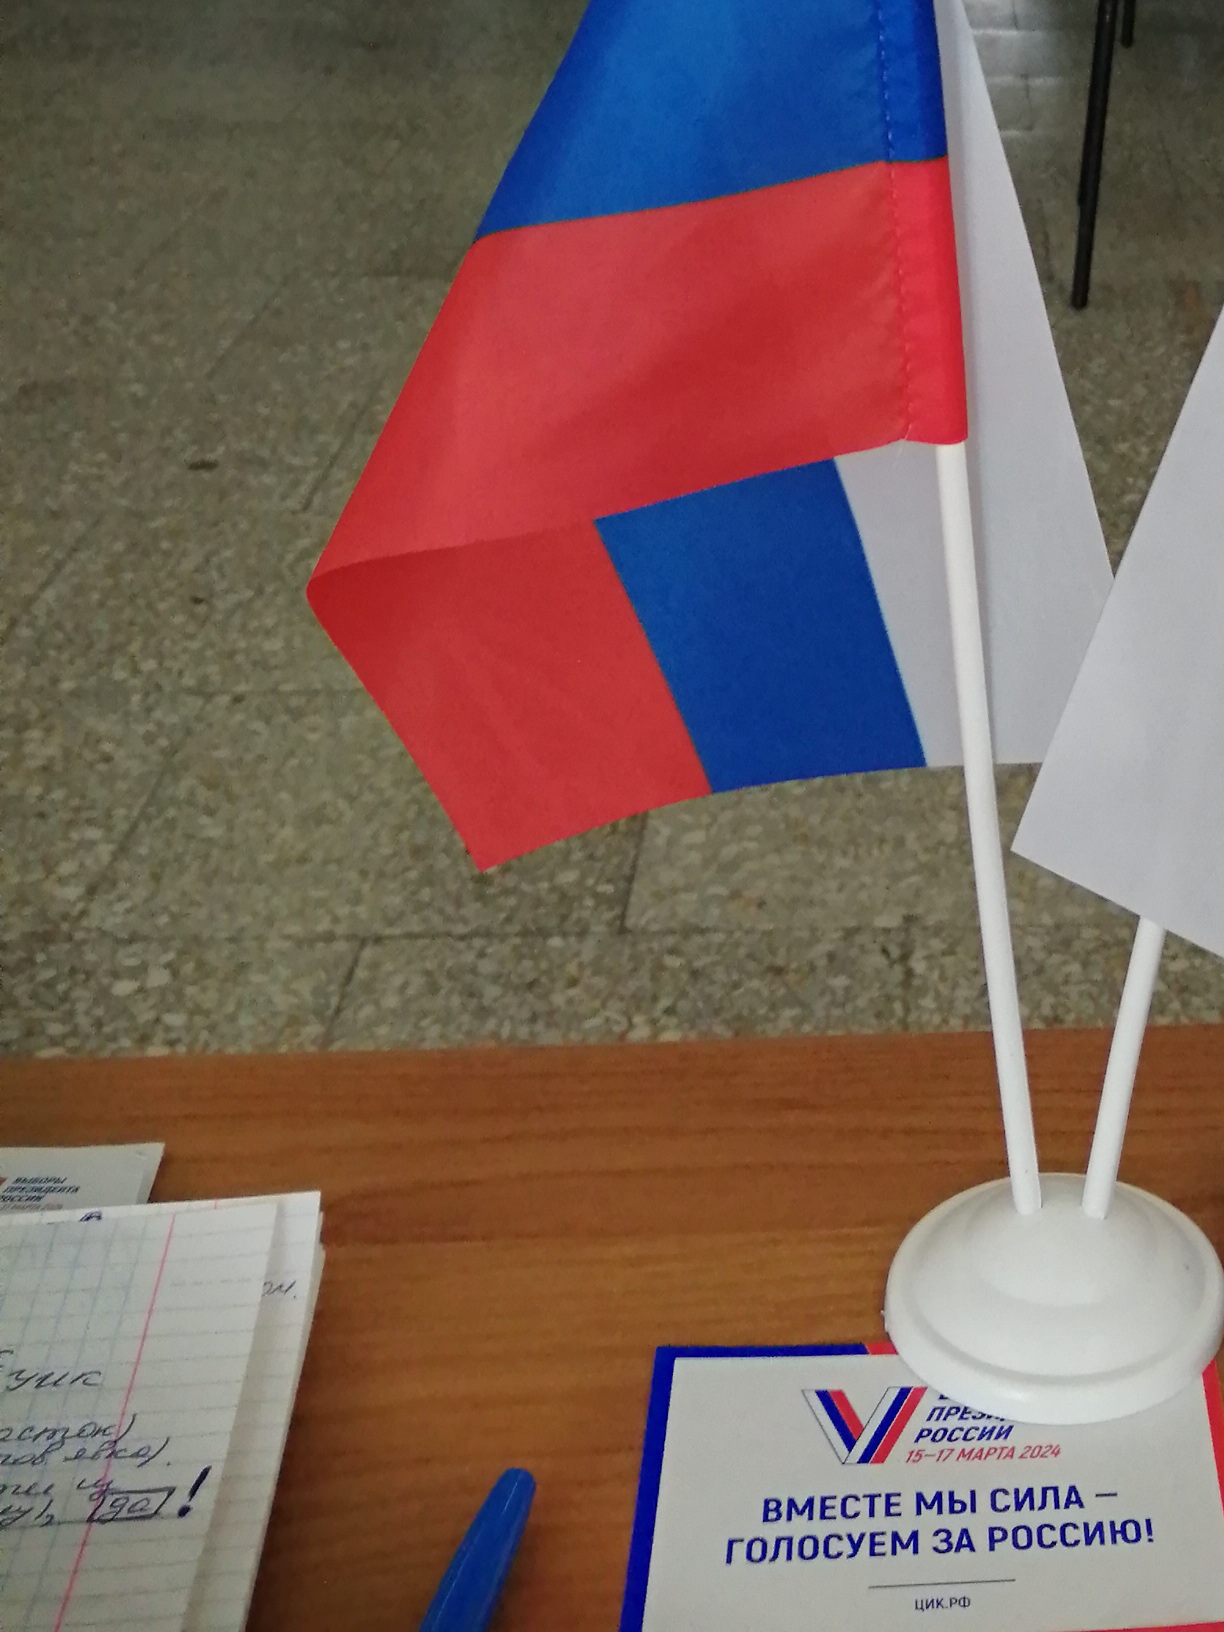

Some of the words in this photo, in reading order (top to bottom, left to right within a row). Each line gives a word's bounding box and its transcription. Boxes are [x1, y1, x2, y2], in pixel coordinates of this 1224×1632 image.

[913, 1425, 1015, 1444] РОССИИ
[956, 1446, 1016, 1462] МАРТА
[1017, 1444, 1061, 1460] 2024
[762, 1492, 902, 1523] ВМЕСТЕ
[915, 1489, 977, 1517] МЫ
[989, 1485, 1085, 1514] СИЛА
[725, 1529, 919, 1565] ГОЛОСУЕМ
[931, 1526, 977, 1554] ЗА
[987, 1519, 1155, 1552] РОССИЮ!
[913, 1595, 971, 1611] ЦИК.РФ
